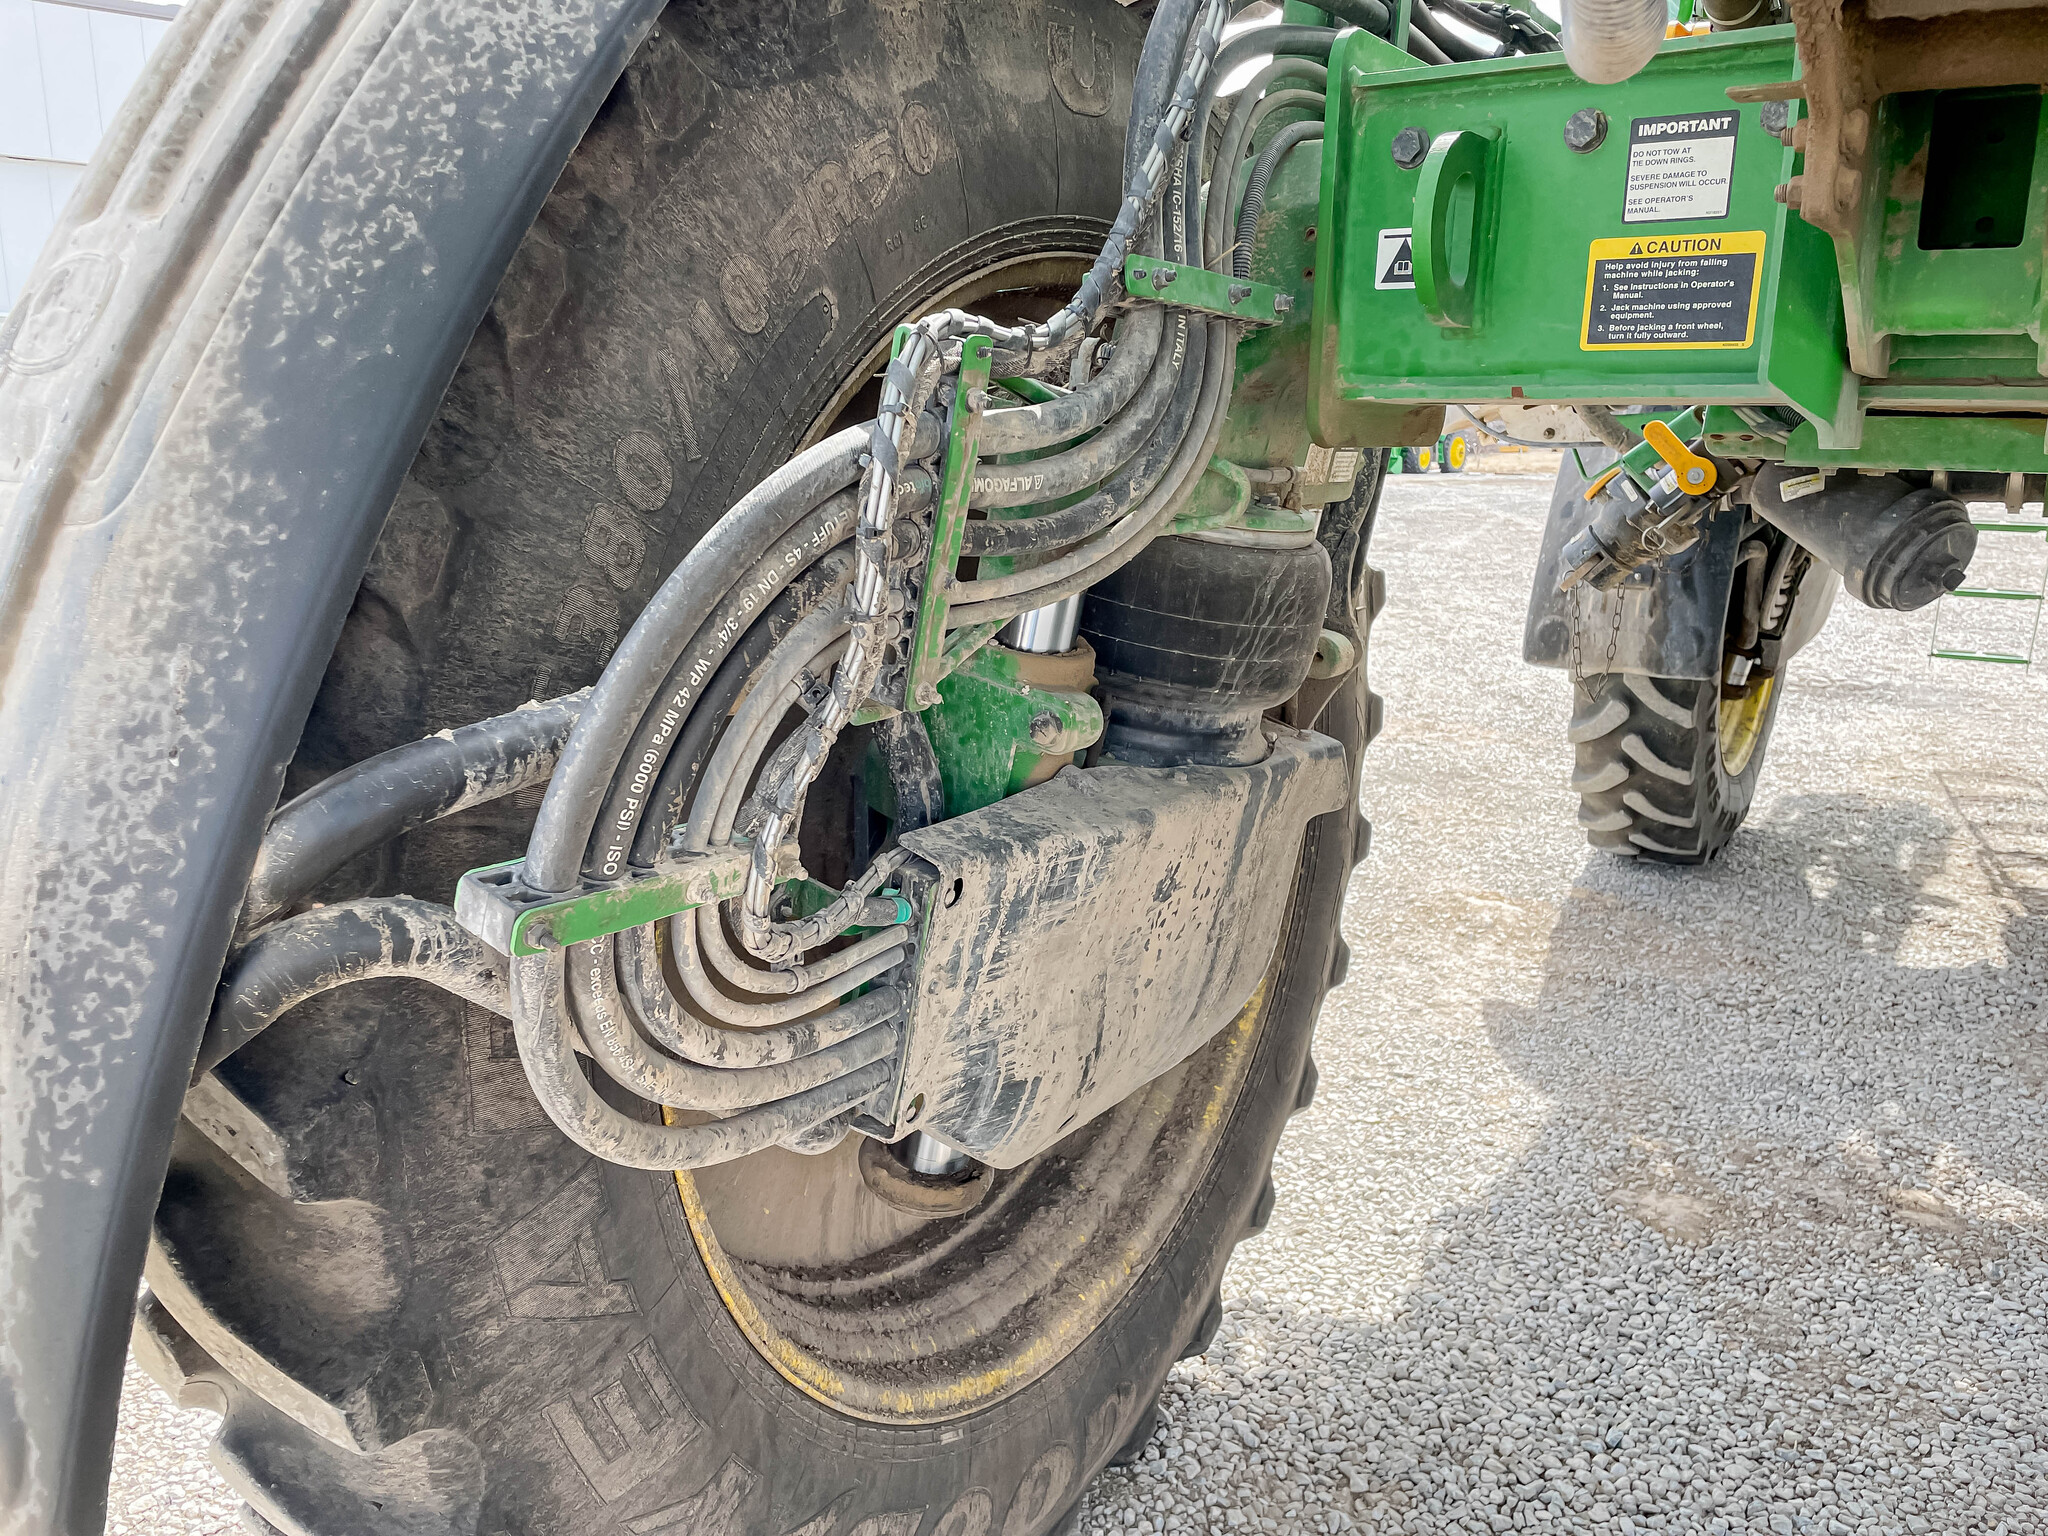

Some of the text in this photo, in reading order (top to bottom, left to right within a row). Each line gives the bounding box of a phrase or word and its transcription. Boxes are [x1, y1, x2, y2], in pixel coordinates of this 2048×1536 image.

[1639, 117, 1731, 136] IMPORTANT
[1670, 156, 1695, 164] RINGS.
[1631, 174, 1660, 182] SEVERE
[1663, 171, 1695, 179] DAMAGE
[1630, 182, 1677, 191] SUSPENSION
[1645, 195, 1693, 204] OPERATOR'S
[1172, 191, 1183, 253] IC-152/16
[1647, 238, 1722, 254] CAUTION
[1605, 262, 1623, 271] Help
[1651, 260, 1676, 268] injury
[1700, 258, 1728, 266] falling
[1604, 271, 1639, 279] machine
[1665, 269, 1700, 278] jacking:
[1630, 282, 1679, 290] instructions
[1680, 281, 1689, 289] in
[1690, 280, 1735, 289] Operator's
[1612, 291, 1643, 299] Manual.
[1632, 303, 1665, 311] machine
[1667, 302, 1690, 311] using
[1692, 301, 1732, 310] approved
[1610, 311, 1654, 320] equipment.
[1608, 332, 1625, 340] turn
[1633, 332, 1651, 340] fully
[1653, 331, 1689, 339] outward.
[1609, 324, 1635, 332] Before
[1637, 323, 1665, 332] jacking
[1675, 322, 1695, 330] front
[1697, 322, 1724, 330] wheel,
[1172, 314, 1186, 370] IN ITALY
[785, 547, 802, 569] 4S
[758, 569, 780, 595] DN
[743, 592, 760, 611] 19
[690, 658, 712, 687] WP
[672, 687, 691, 709] 42
[652, 709, 680, 745] MPa
[630, 748, 660, 794] (6000
[616, 797, 640, 831] PSI)
[603, 845, 623, 875] ISO
[599, 1019, 617, 1039] EN
